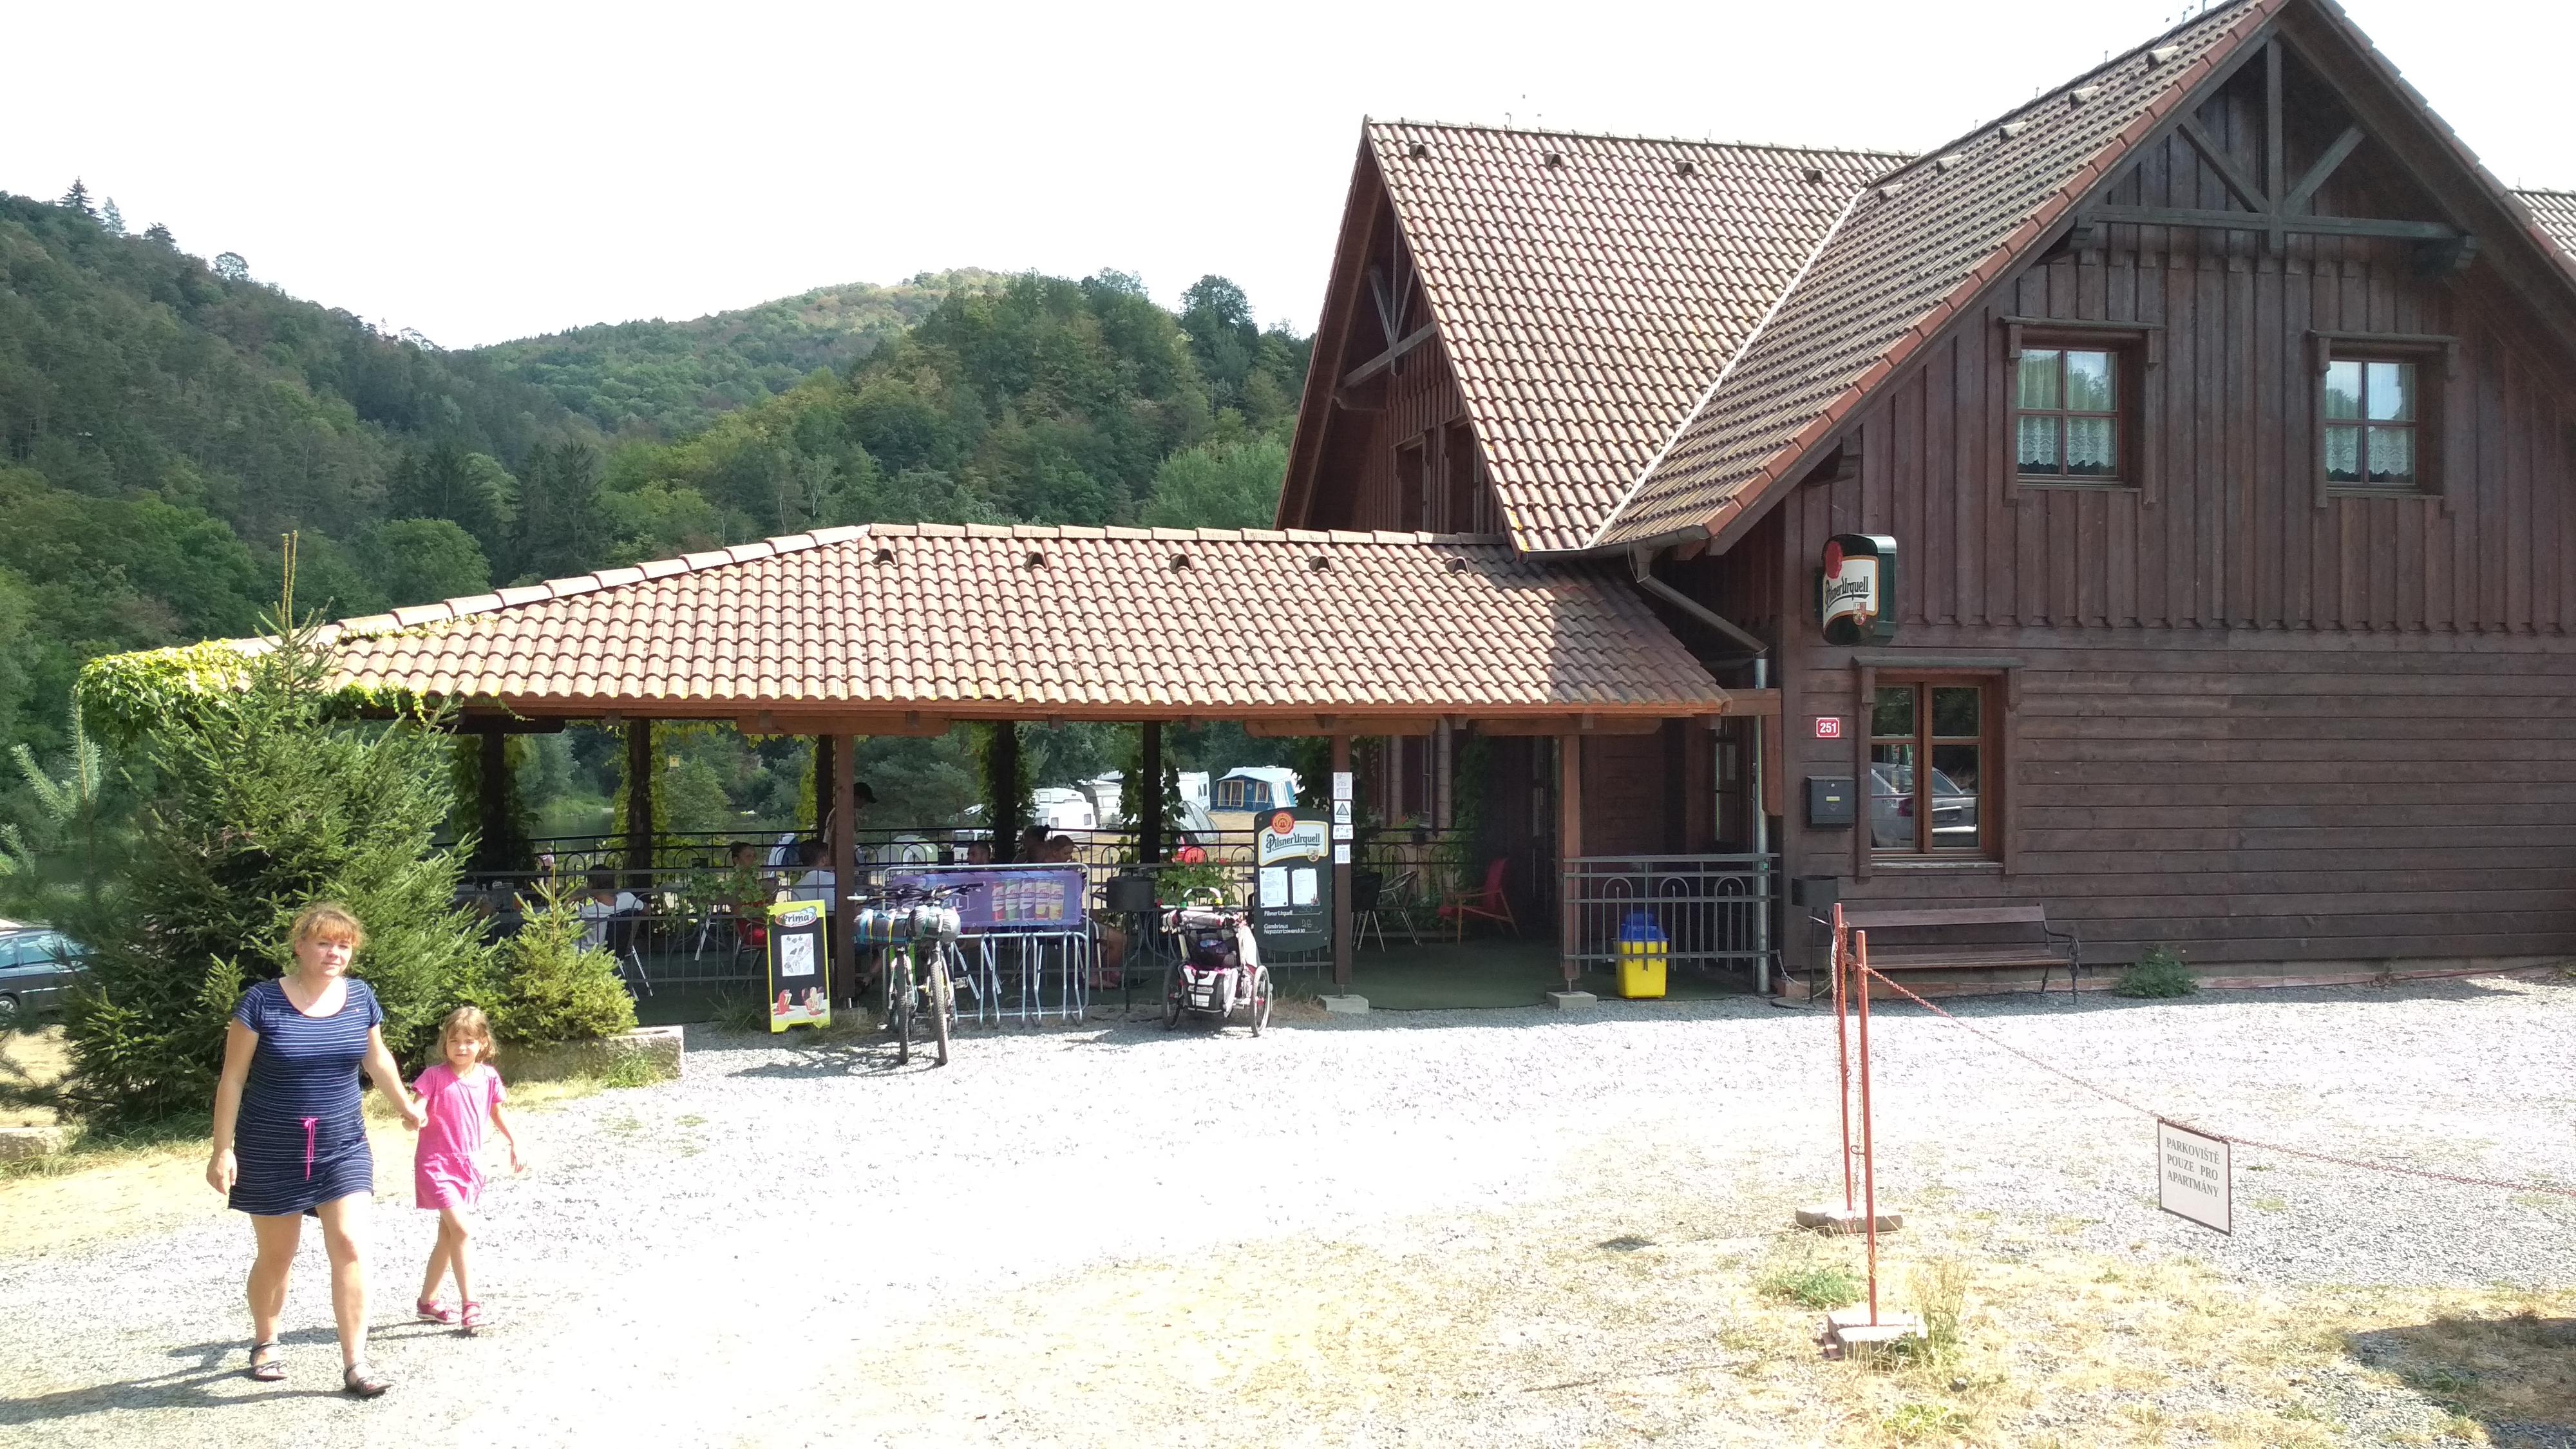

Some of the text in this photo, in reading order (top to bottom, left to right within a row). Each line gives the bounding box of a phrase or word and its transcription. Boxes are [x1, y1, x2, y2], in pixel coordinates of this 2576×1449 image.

[1825, 576, 1869, 613] Pilsner Urquell
[1819, 722, 1837, 734] 251
[1265, 833, 1294, 853] Pilsner
[1293, 833, 1320, 848] Urquell
[782, 914, 810, 923] Prima
[2166, 1137, 2220, 1164] PARKOVIŠTĚ
[2167, 1153, 2218, 1180] POUZE PRO
[2167, 1170, 2219, 1197] APARTMÁNY
